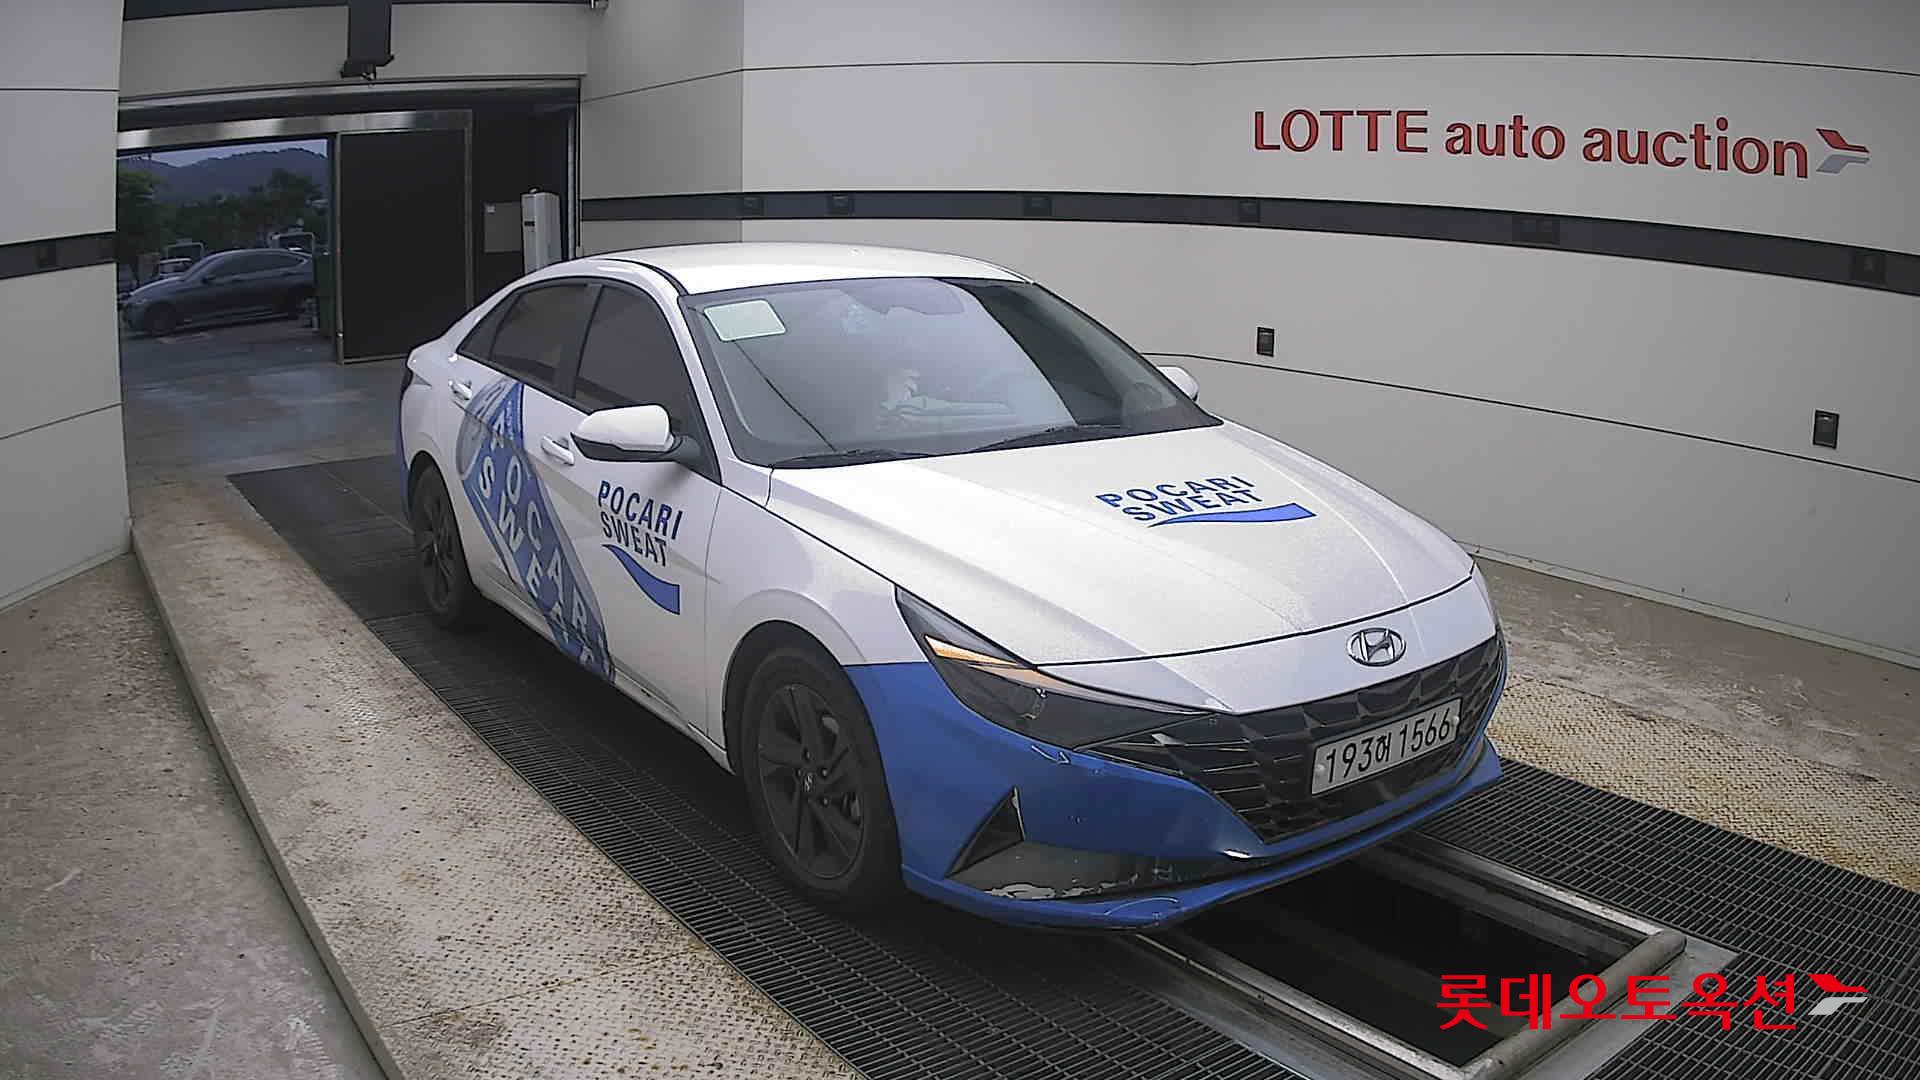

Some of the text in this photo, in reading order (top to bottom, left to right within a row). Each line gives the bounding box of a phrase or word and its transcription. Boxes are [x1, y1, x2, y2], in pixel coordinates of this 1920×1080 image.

[1254, 109, 1809, 179] LOTTE auto auction
[598, 480, 683, 540] POCARI
[1095, 475, 1256, 508] POCARI
[1122, 488, 1263, 522] SWEAT
[600, 510, 668, 567] SWEAT
